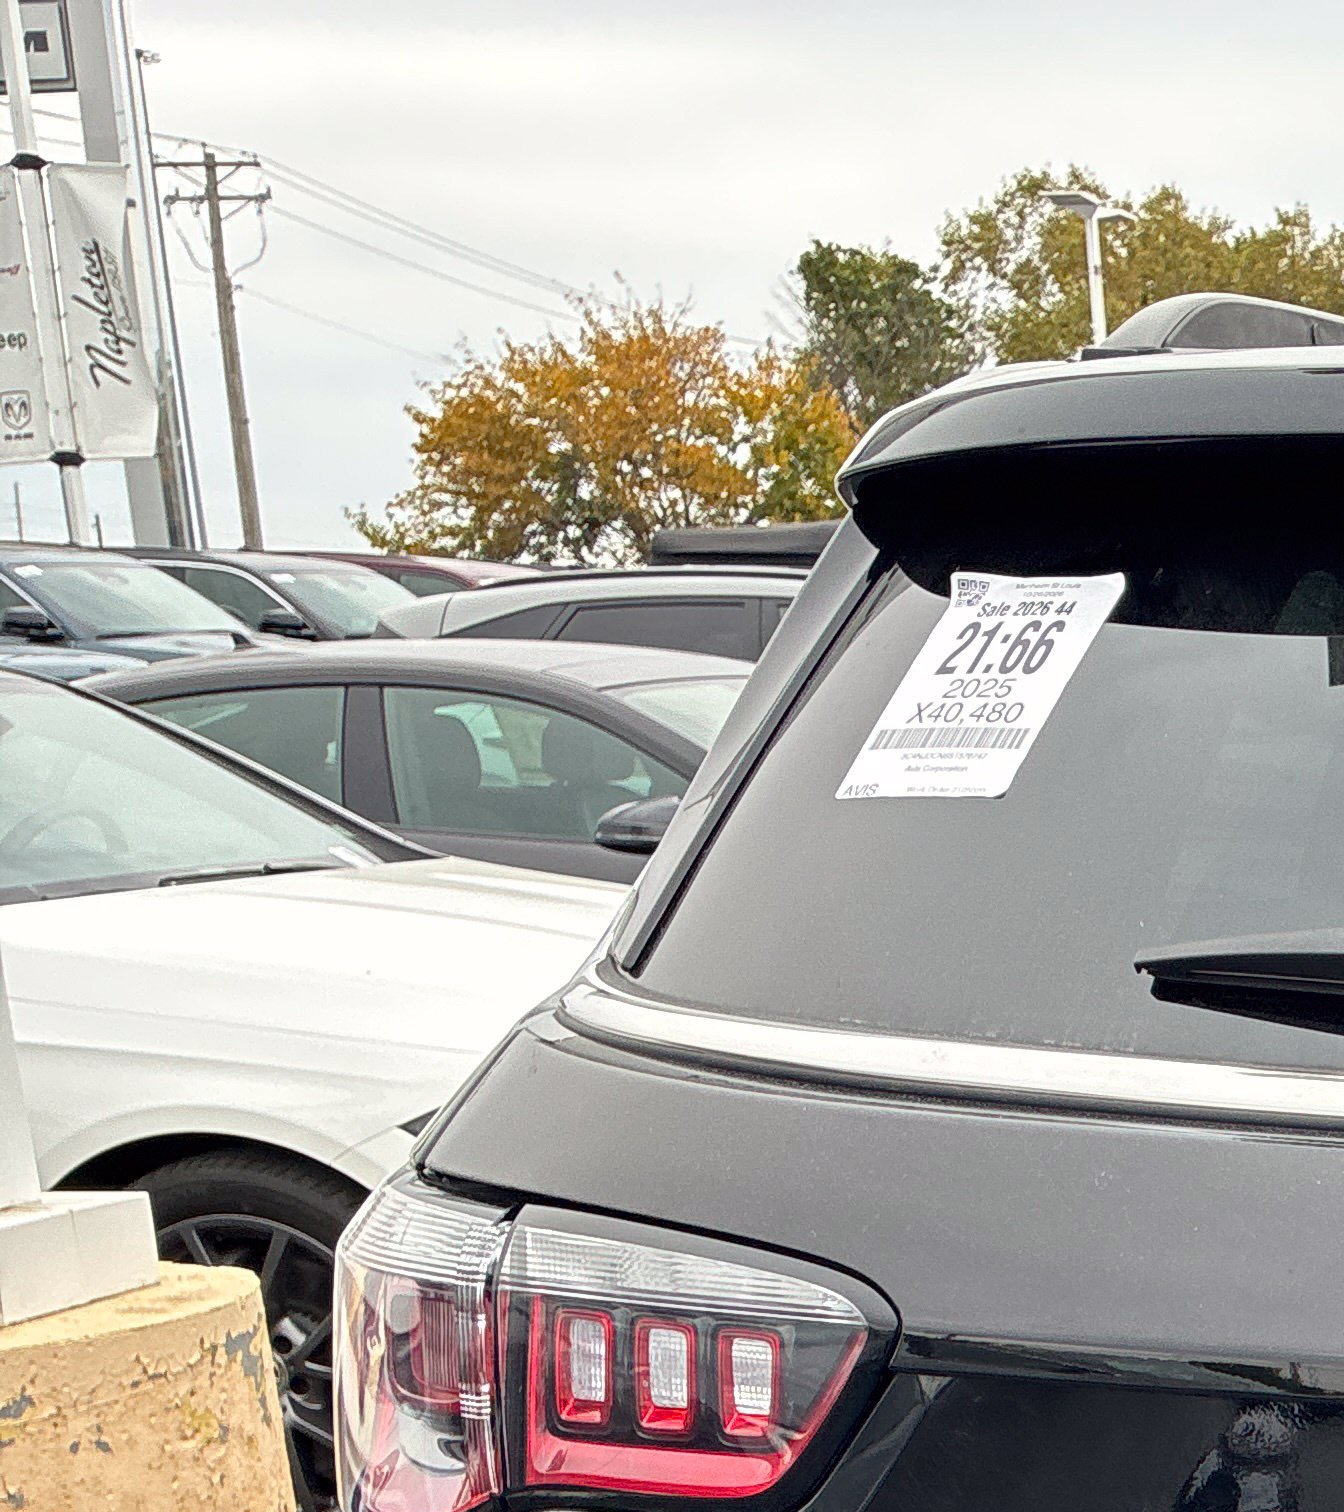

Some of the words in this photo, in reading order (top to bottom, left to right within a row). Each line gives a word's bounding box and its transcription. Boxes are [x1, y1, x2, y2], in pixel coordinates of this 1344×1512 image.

[71, 237, 136, 389] Napleton
[976, 602, 1011, 617] Sale
[1012, 600, 1054, 617] 2026
[1055, 600, 1078, 616] 44
[934, 619, 1066, 676] 21:66
[942, 678, 1017, 699] 2025
[905, 701, 1025, 726] X40,480
[842, 783, 880, 797] AVIS
